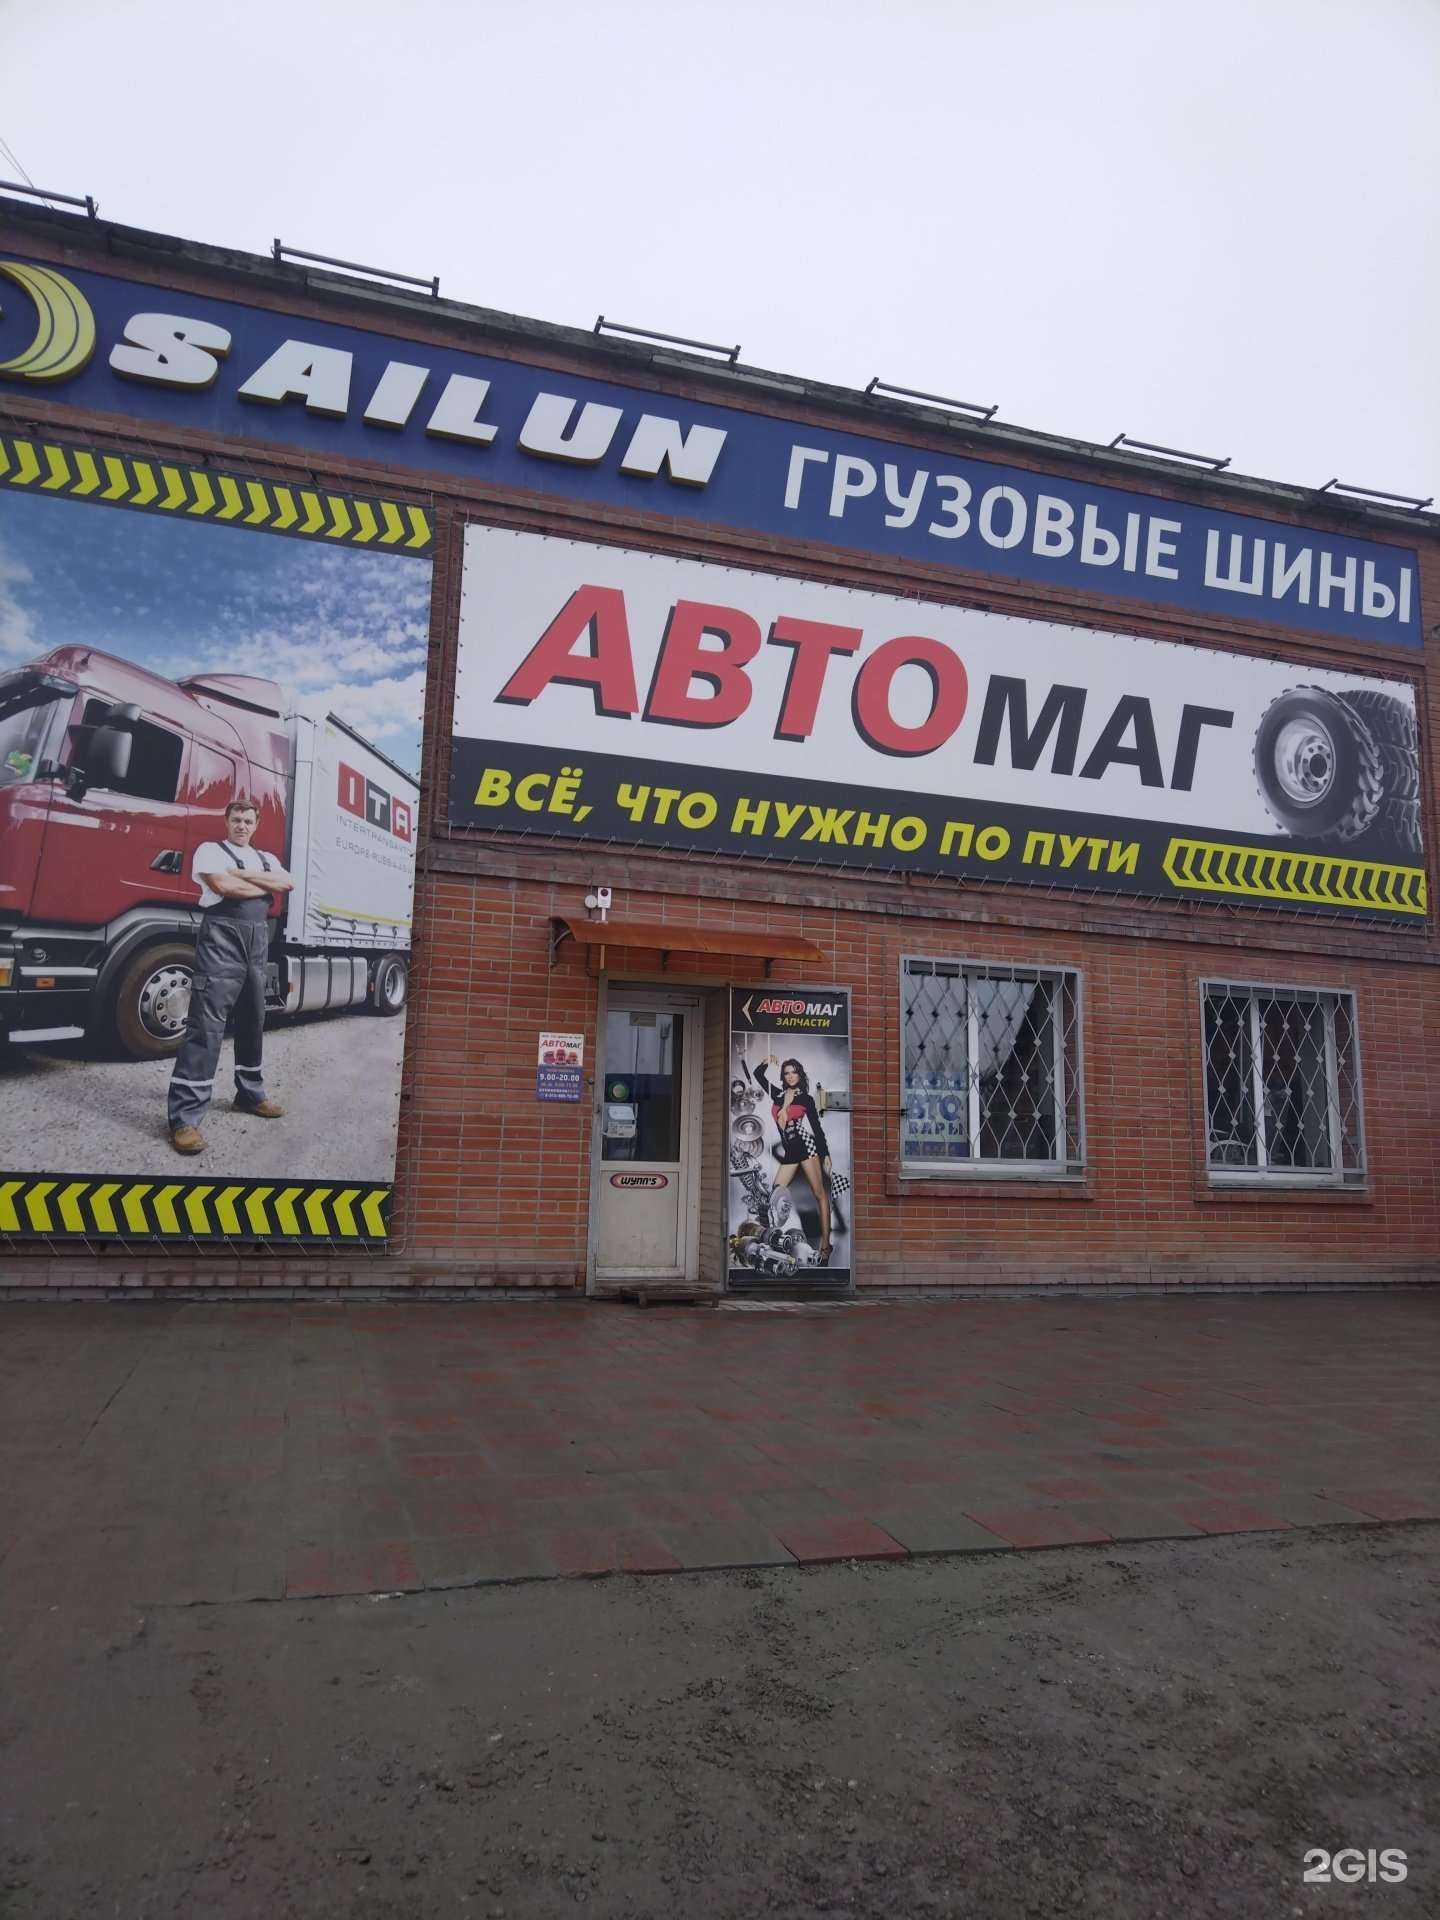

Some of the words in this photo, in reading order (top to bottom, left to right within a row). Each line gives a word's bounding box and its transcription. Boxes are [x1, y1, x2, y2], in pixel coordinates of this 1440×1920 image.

[109, 312, 728, 486] SAILUN
[783, 445, 1183, 580] ГРУЗОВЫЕ
[1203, 528, 1413, 623] ШИНЫ
[493, 583, 1234, 792] АВТОМАГ
[346, 774, 409, 837] ITA
[474, 766, 594, 823] ВСЁ,
[616, 783, 717, 829] ЧТО
[730, 798, 928, 852] НУЖНО
[939, 821, 1011, 861] ПО
[1022, 831, 1141, 875] ПУТИ
[540, 1039, 582, 1049] АВТОМАГ
[756, 998, 844, 1017] АВТОМАГ
[776, 1017, 831, 1028] ЗАПЧАСТИ
